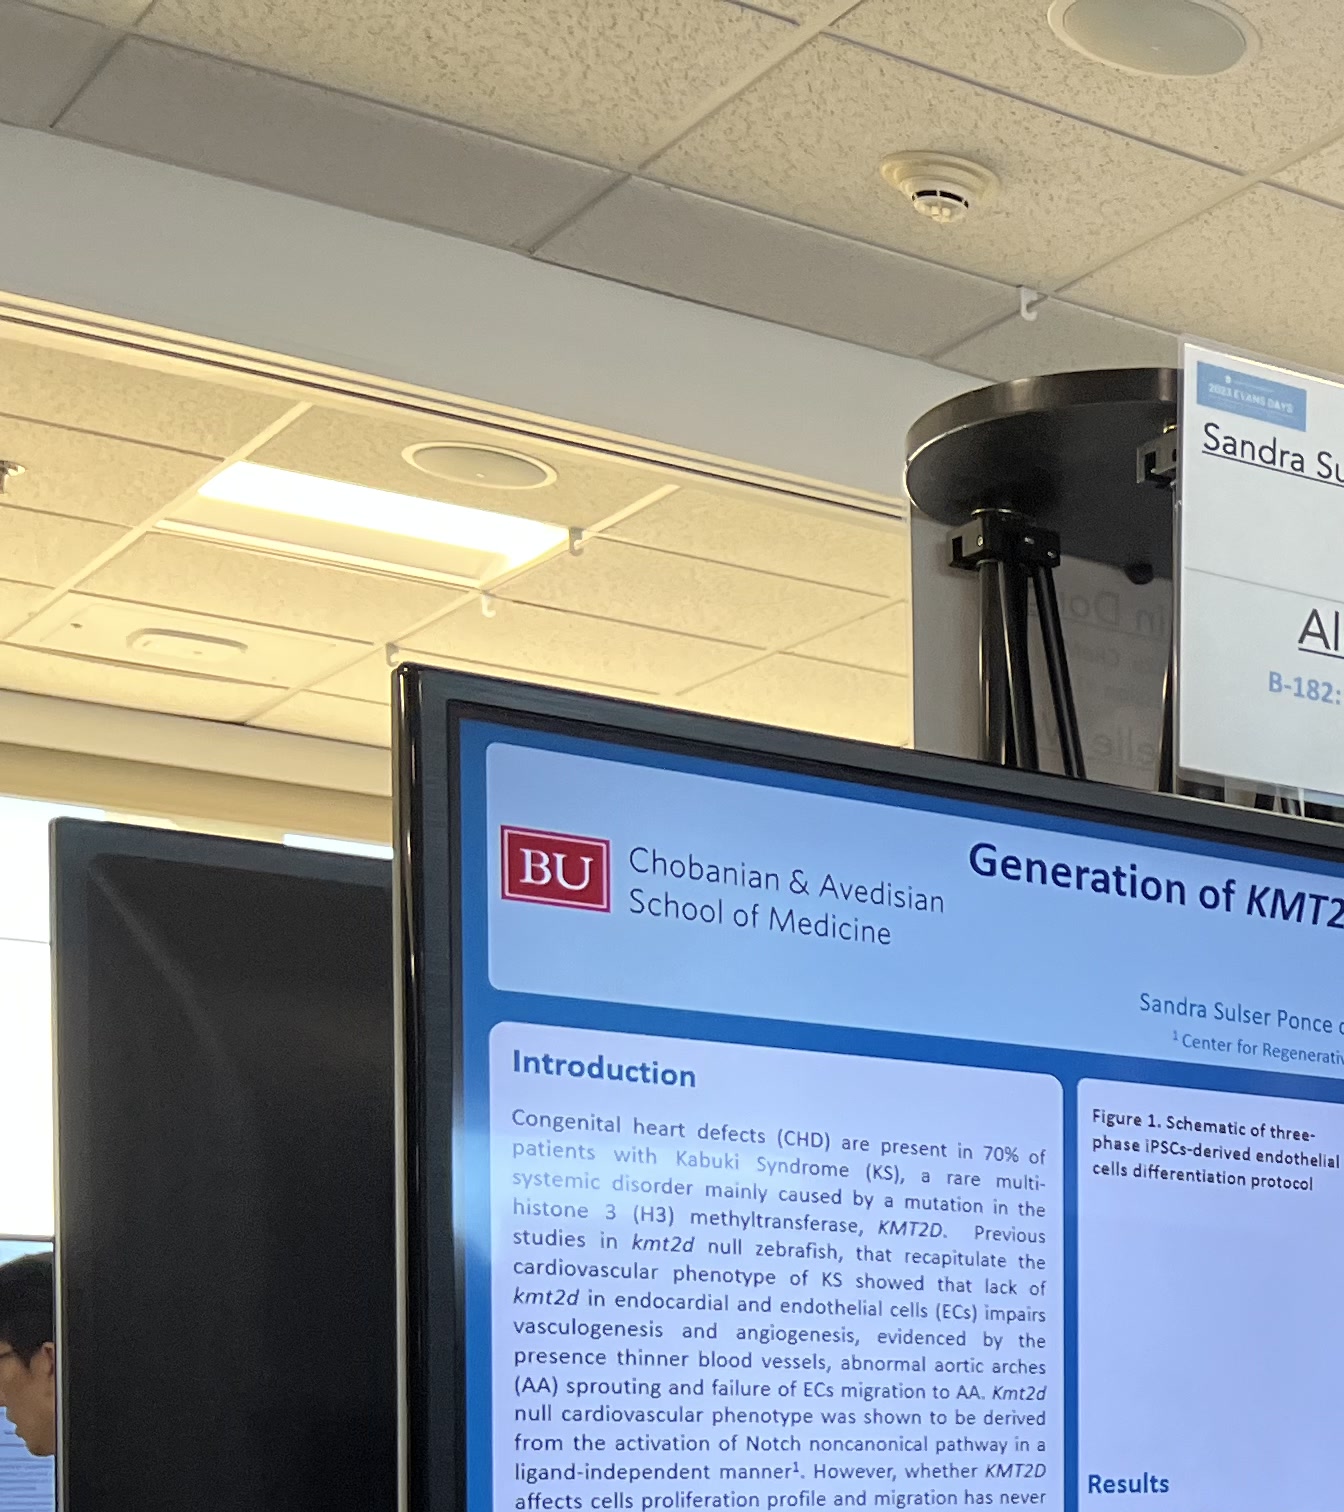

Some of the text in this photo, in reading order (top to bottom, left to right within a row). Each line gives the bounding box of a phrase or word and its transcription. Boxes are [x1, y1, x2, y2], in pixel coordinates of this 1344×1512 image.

[1203, 422, 1304, 472] Sandra
[1269, 671, 1341, 703] B-182:
[518, 848, 594, 892] BU
[629, 847, 943, 911] Chobanian & Avedisian
[969, 843, 1185, 903] Generation
[1198, 878, 1236, 911] of
[629, 888, 890, 944] School of Medicine
[1139, 992, 1206, 1018] Sandra
[1213, 1001, 1271, 1025] Sulser
[1277, 1009, 1332, 1033] Ponce
[1182, 1033, 1232, 1051] Center
[1237, 1038, 1258, 1055] for
[513, 1050, 695, 1086] Introduction
[1092, 1108, 1315, 1141] Figure 1. Schematic of three-
[1092, 1134, 1339, 1168] phase iPSCs-derived endothelial
[1092, 1161, 1312, 1190] cells differentiation protocol
[1088, 1472, 1169, 1493] Results
